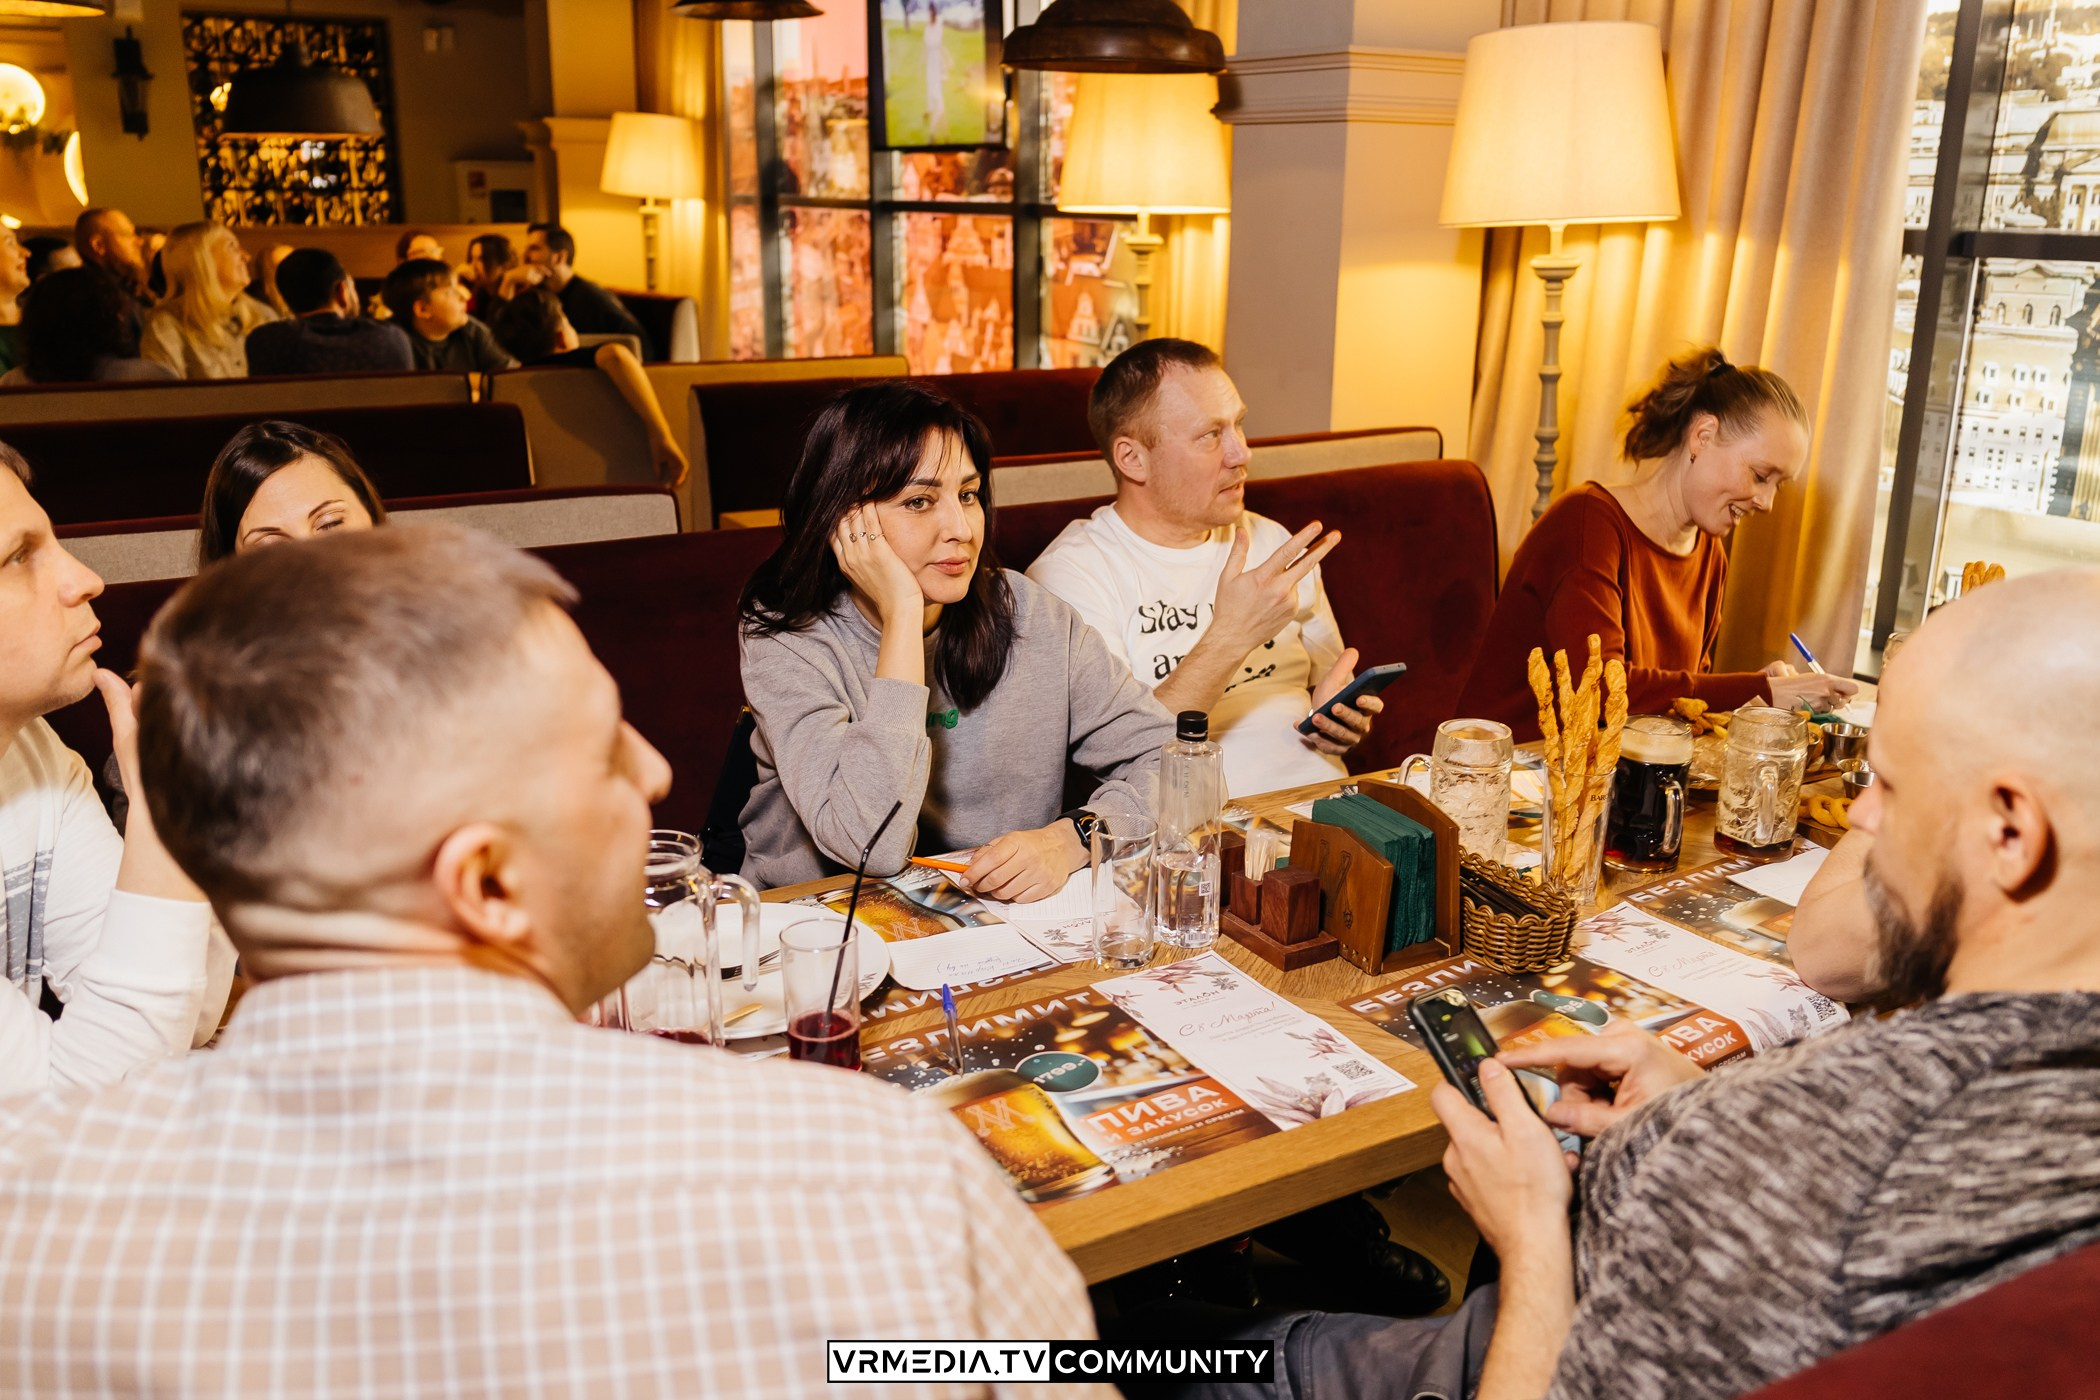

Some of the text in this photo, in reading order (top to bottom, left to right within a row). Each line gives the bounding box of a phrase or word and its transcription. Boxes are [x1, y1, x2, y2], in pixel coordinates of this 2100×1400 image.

[1138, 600, 1199, 634] Stay
[1087, 1085, 1221, 1133] ПИВА
[1126, 1098, 1230, 1137] ЗАКУСОК
